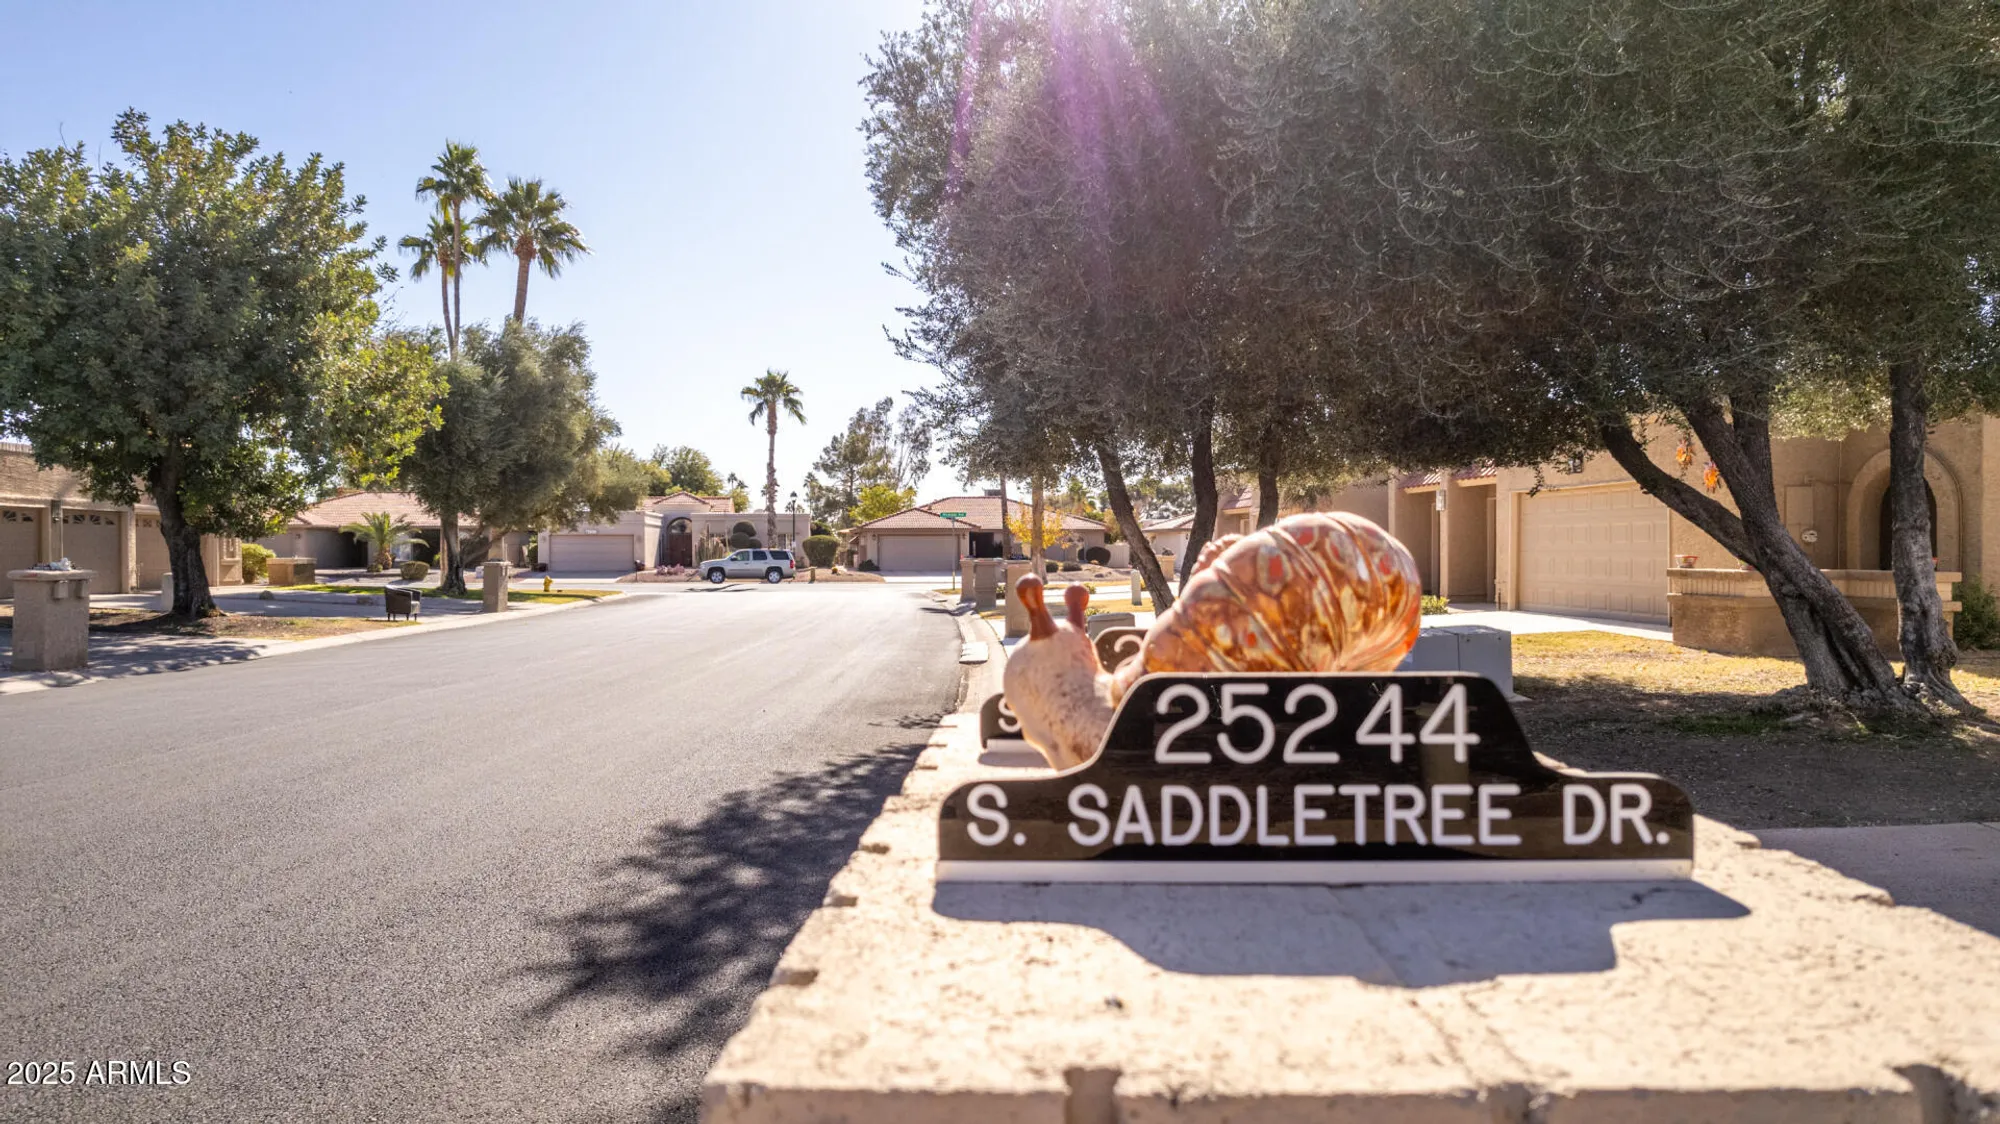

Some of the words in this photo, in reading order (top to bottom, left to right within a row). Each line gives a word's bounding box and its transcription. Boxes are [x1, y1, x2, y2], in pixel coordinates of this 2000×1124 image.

[1156, 684, 1481, 764] 25244
[966, 784, 1026, 847] S.
[1067, 784, 1522, 847] SADDLETREE
[1562, 784, 1671, 847] DR.
